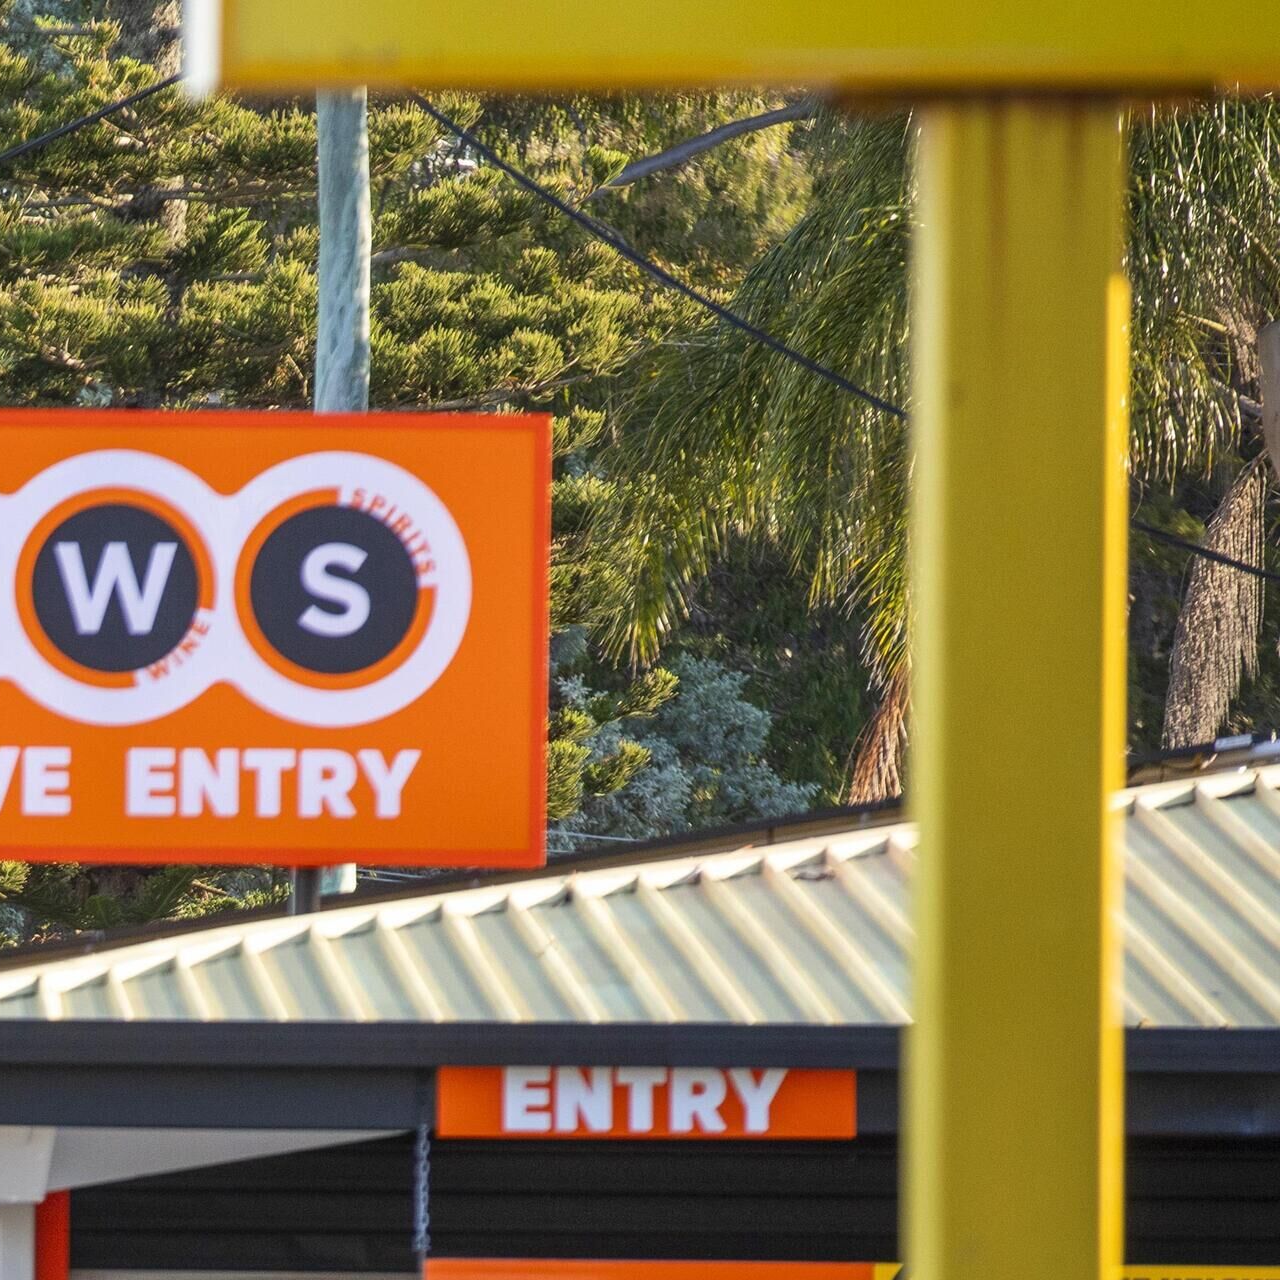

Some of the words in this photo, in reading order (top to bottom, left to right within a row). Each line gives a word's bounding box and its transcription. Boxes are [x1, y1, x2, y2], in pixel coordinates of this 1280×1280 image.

[351, 487, 438, 575] SPIRITS
[147, 619, 211, 682] WINE
[125, 746, 423, 820] ENTRY
[502, 1067, 787, 1134] ENTRY
